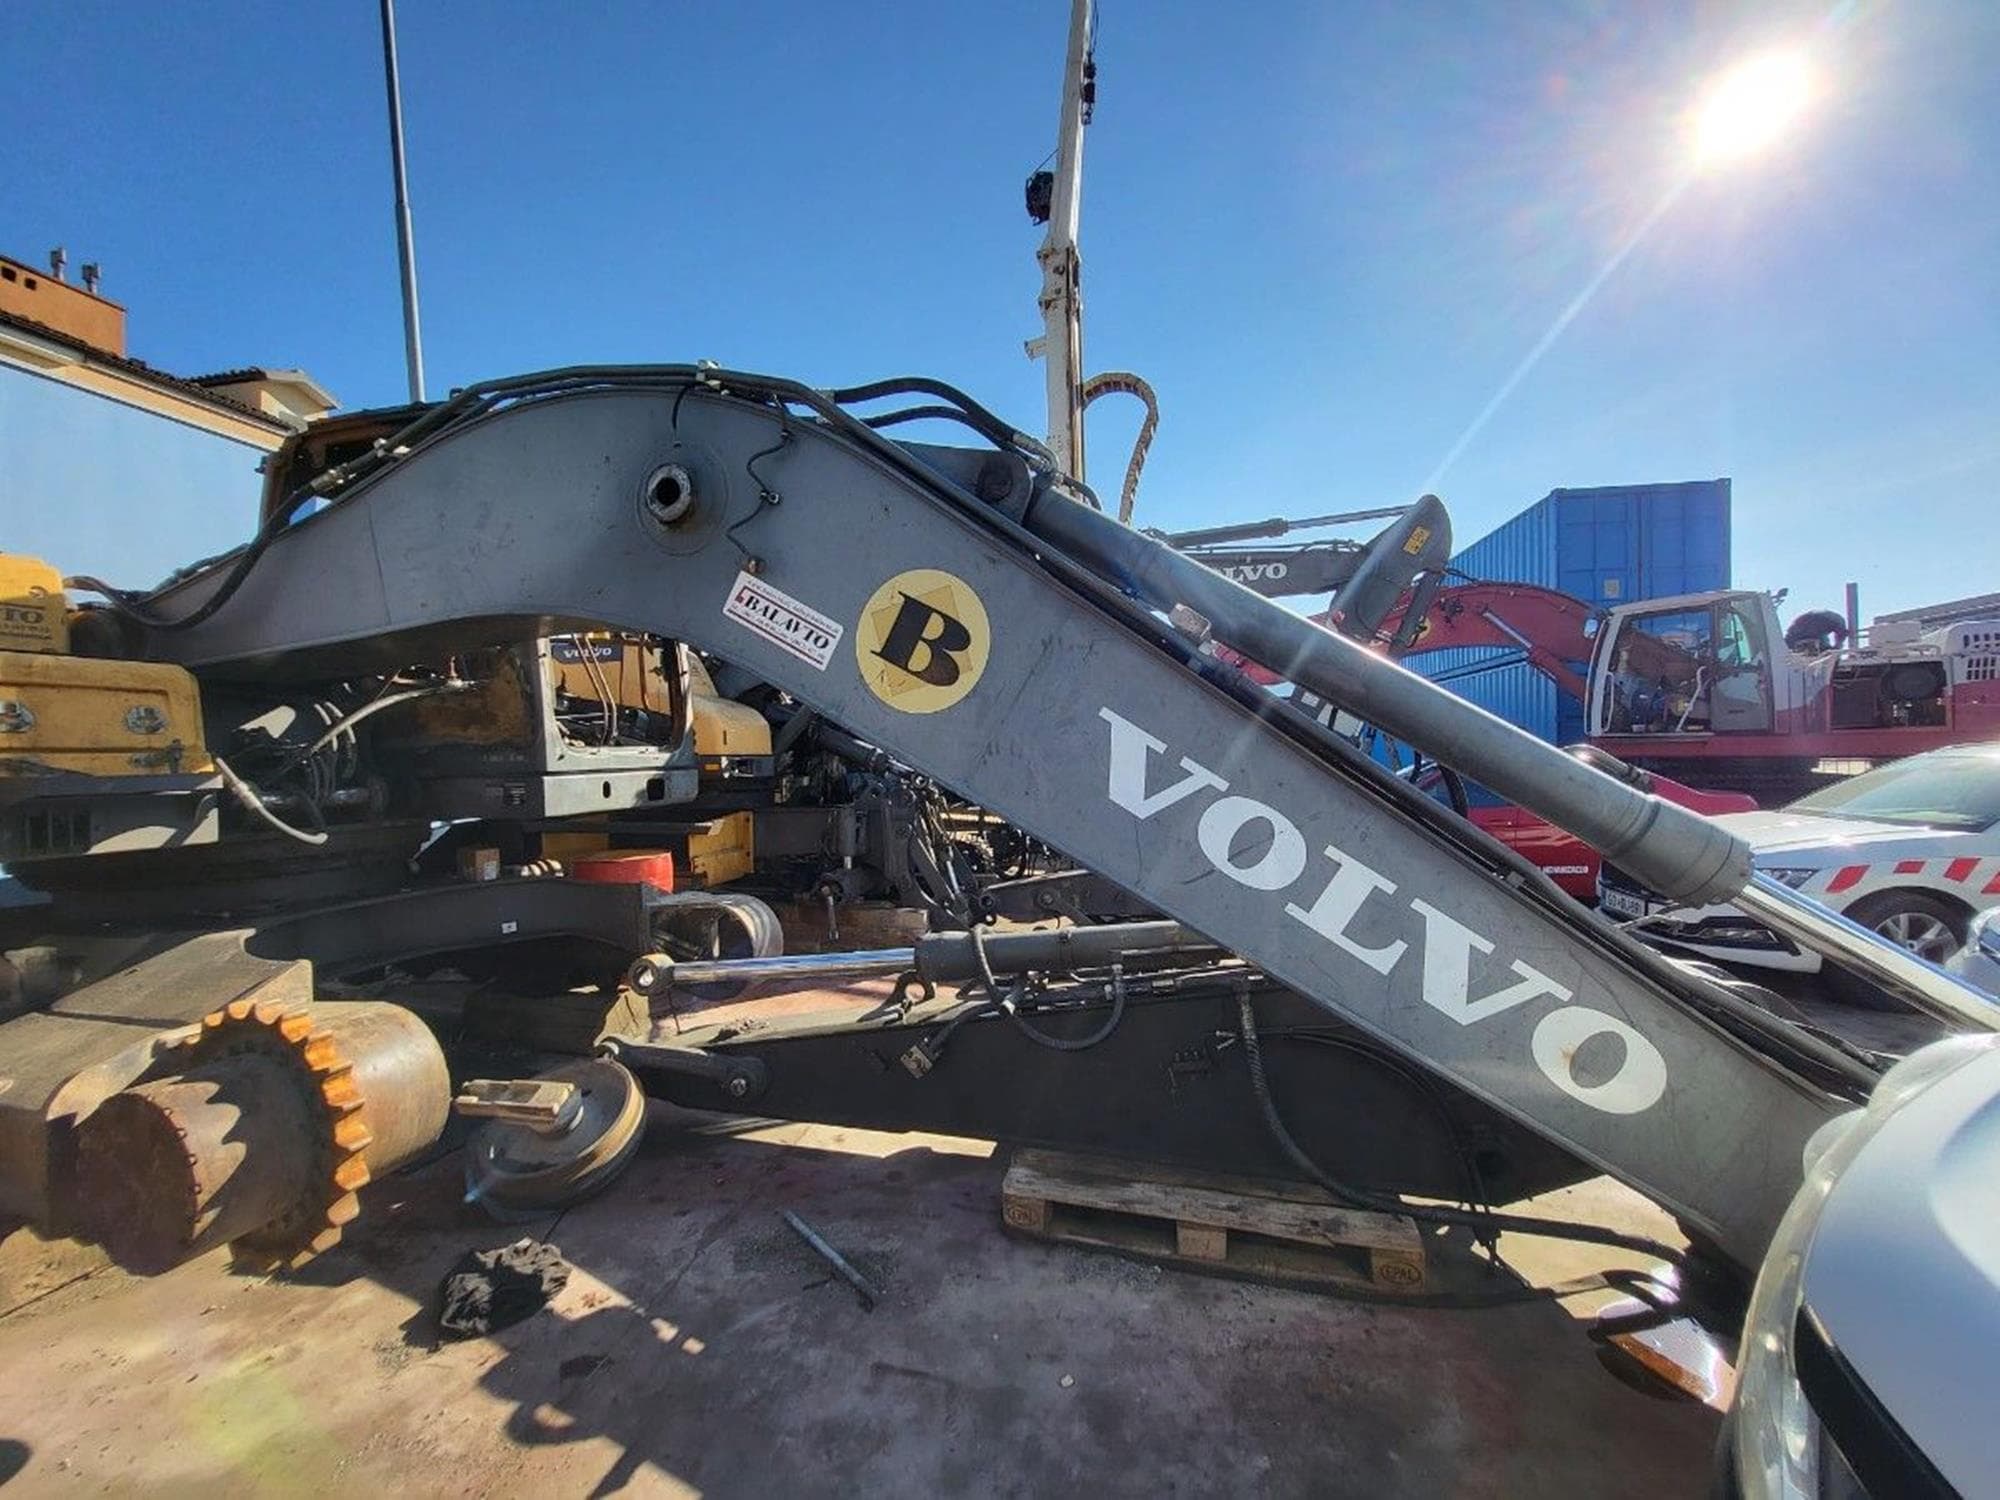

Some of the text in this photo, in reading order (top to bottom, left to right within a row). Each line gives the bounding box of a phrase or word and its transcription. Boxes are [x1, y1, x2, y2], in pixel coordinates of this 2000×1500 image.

[1222, 563, 1287, 582] LVO
[0, 607, 44, 623] TO
[744, 595, 830, 650] BALAVTO
[870, 590, 971, 687] B
[1098, 706, 1668, 1114] VOLVO
